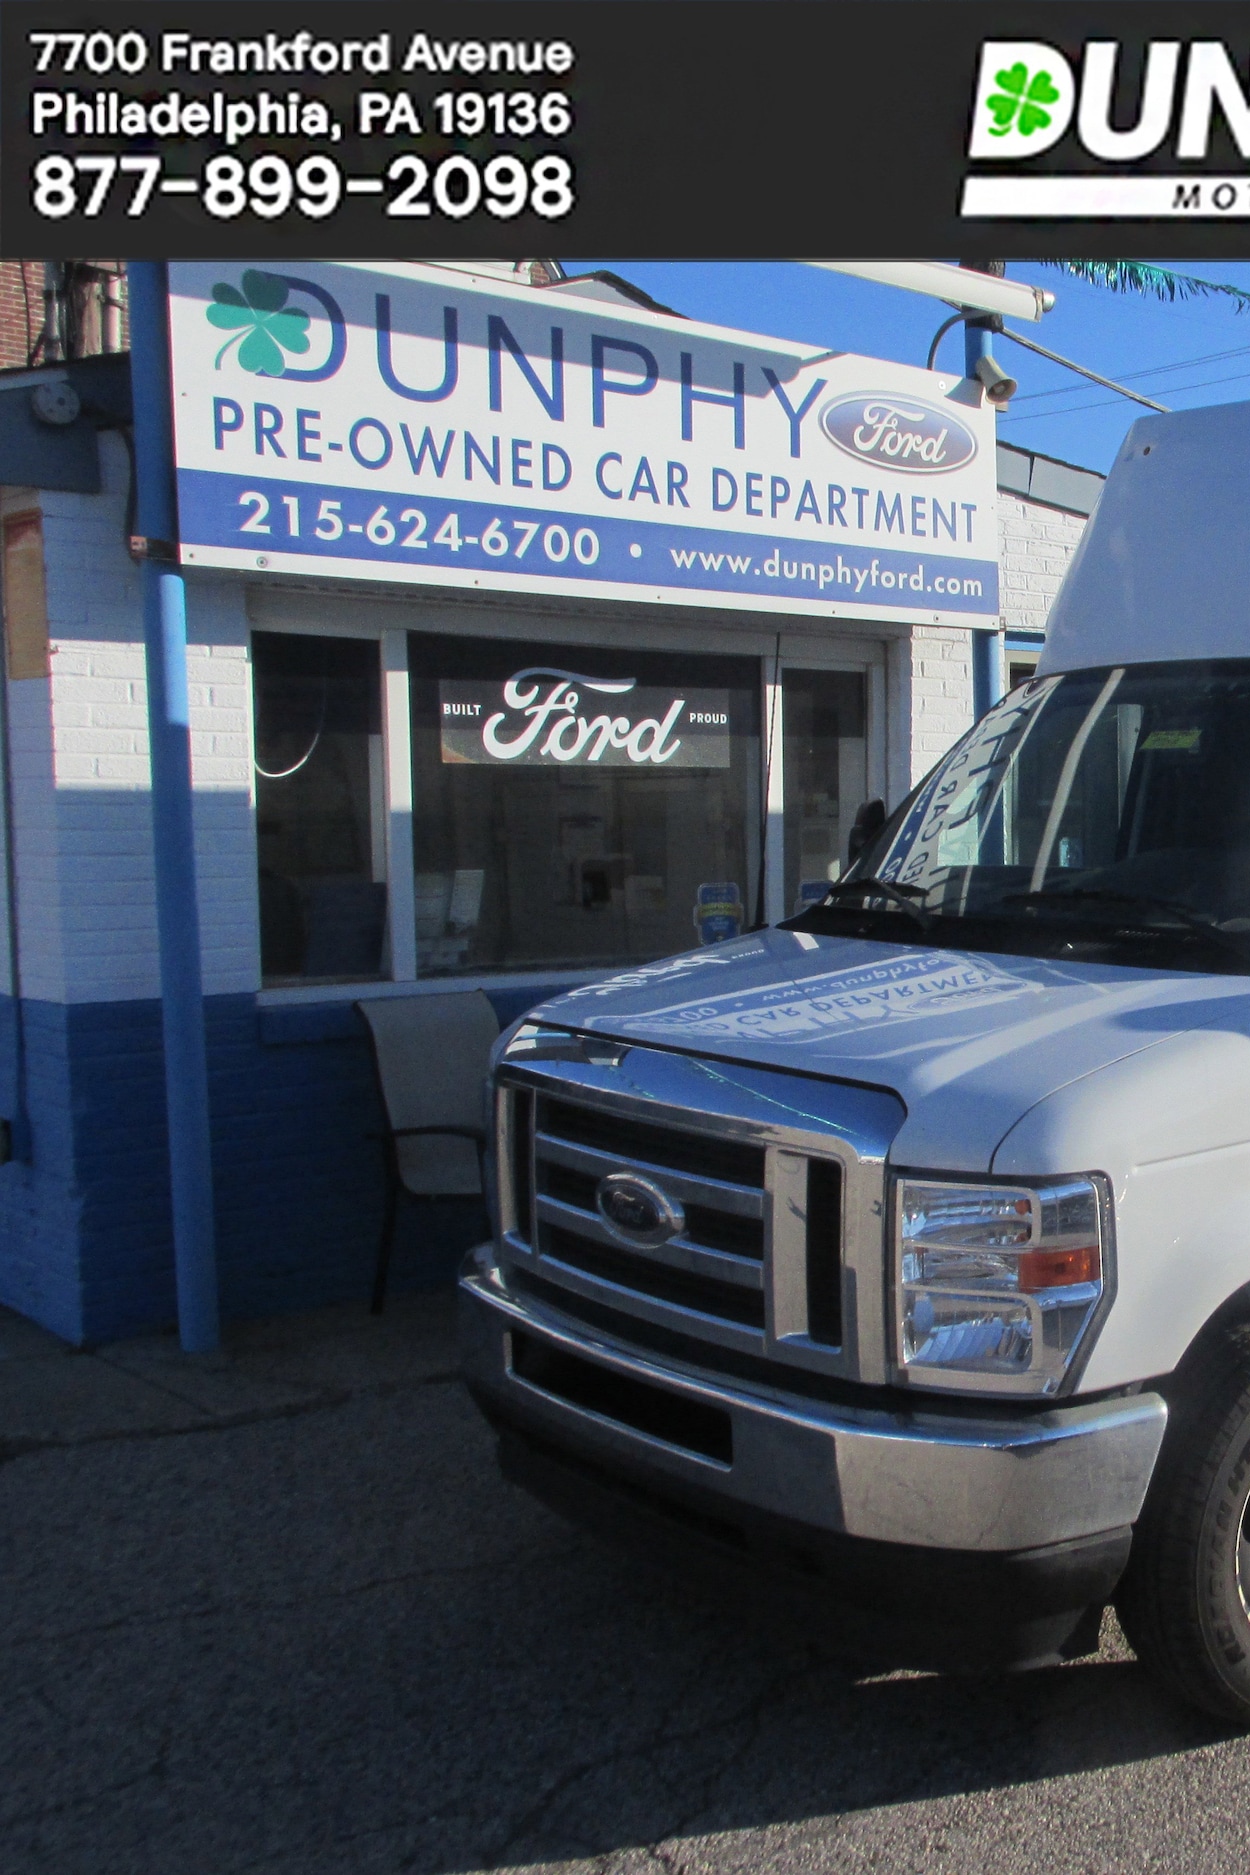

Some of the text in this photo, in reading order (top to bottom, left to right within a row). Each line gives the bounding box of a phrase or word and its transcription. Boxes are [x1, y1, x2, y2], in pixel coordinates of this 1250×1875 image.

[256, 270, 829, 460] DUNPHY
[853, 403, 949, 466] Ford
[213, 396, 977, 545] PRE-OWNED CAR DEPARTMENT
[239, 491, 600, 566] 215-624-6700
[670, 546, 984, 598] www.dunphyford.com
[442, 703, 482, 717] BUILT
[482, 666, 686, 764] Ford
[689, 712, 728, 725] PROUD
